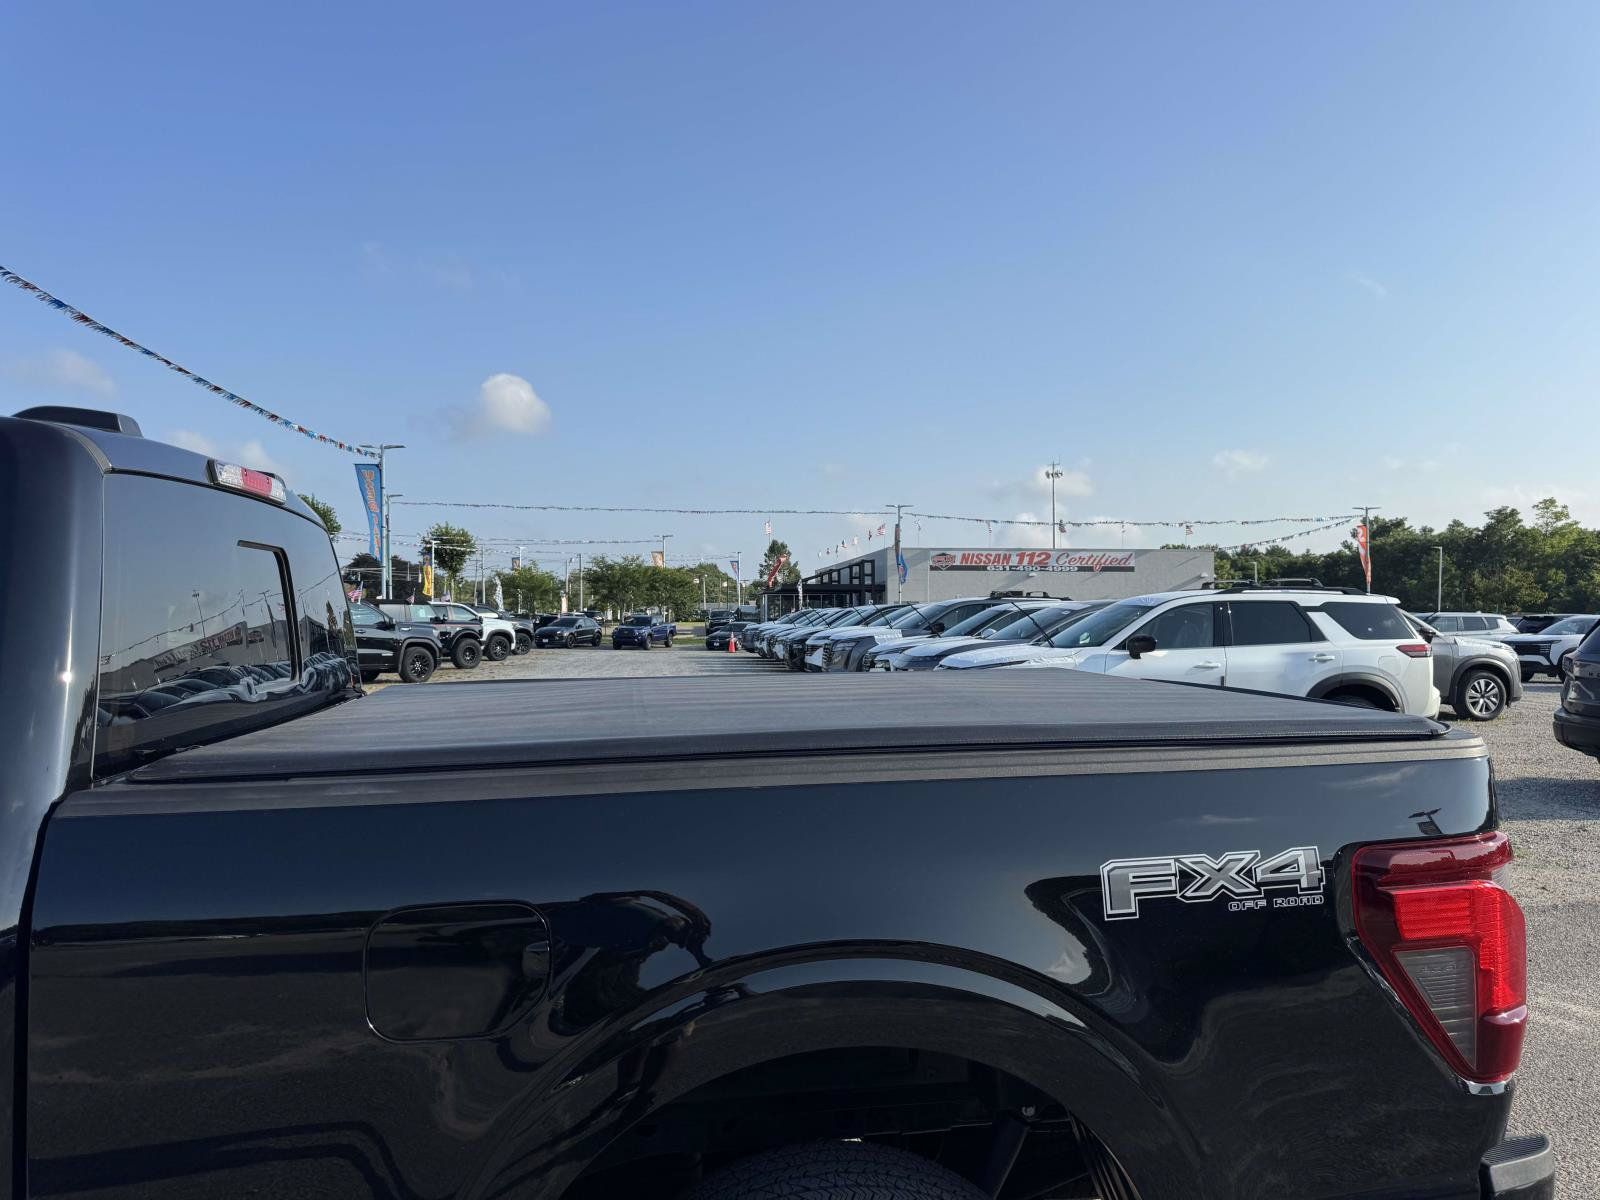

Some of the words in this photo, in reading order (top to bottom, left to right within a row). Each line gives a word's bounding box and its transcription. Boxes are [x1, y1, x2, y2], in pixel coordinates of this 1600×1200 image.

[960, 553, 1012, 565] NISSAN
[1016, 552, 1051, 566] 112
[1055, 552, 1133, 573] Certified
[1100, 846, 1326, 921] FX4
[1228, 899, 1267, 911] OFF
[1273, 895, 1325, 907] ROAD
